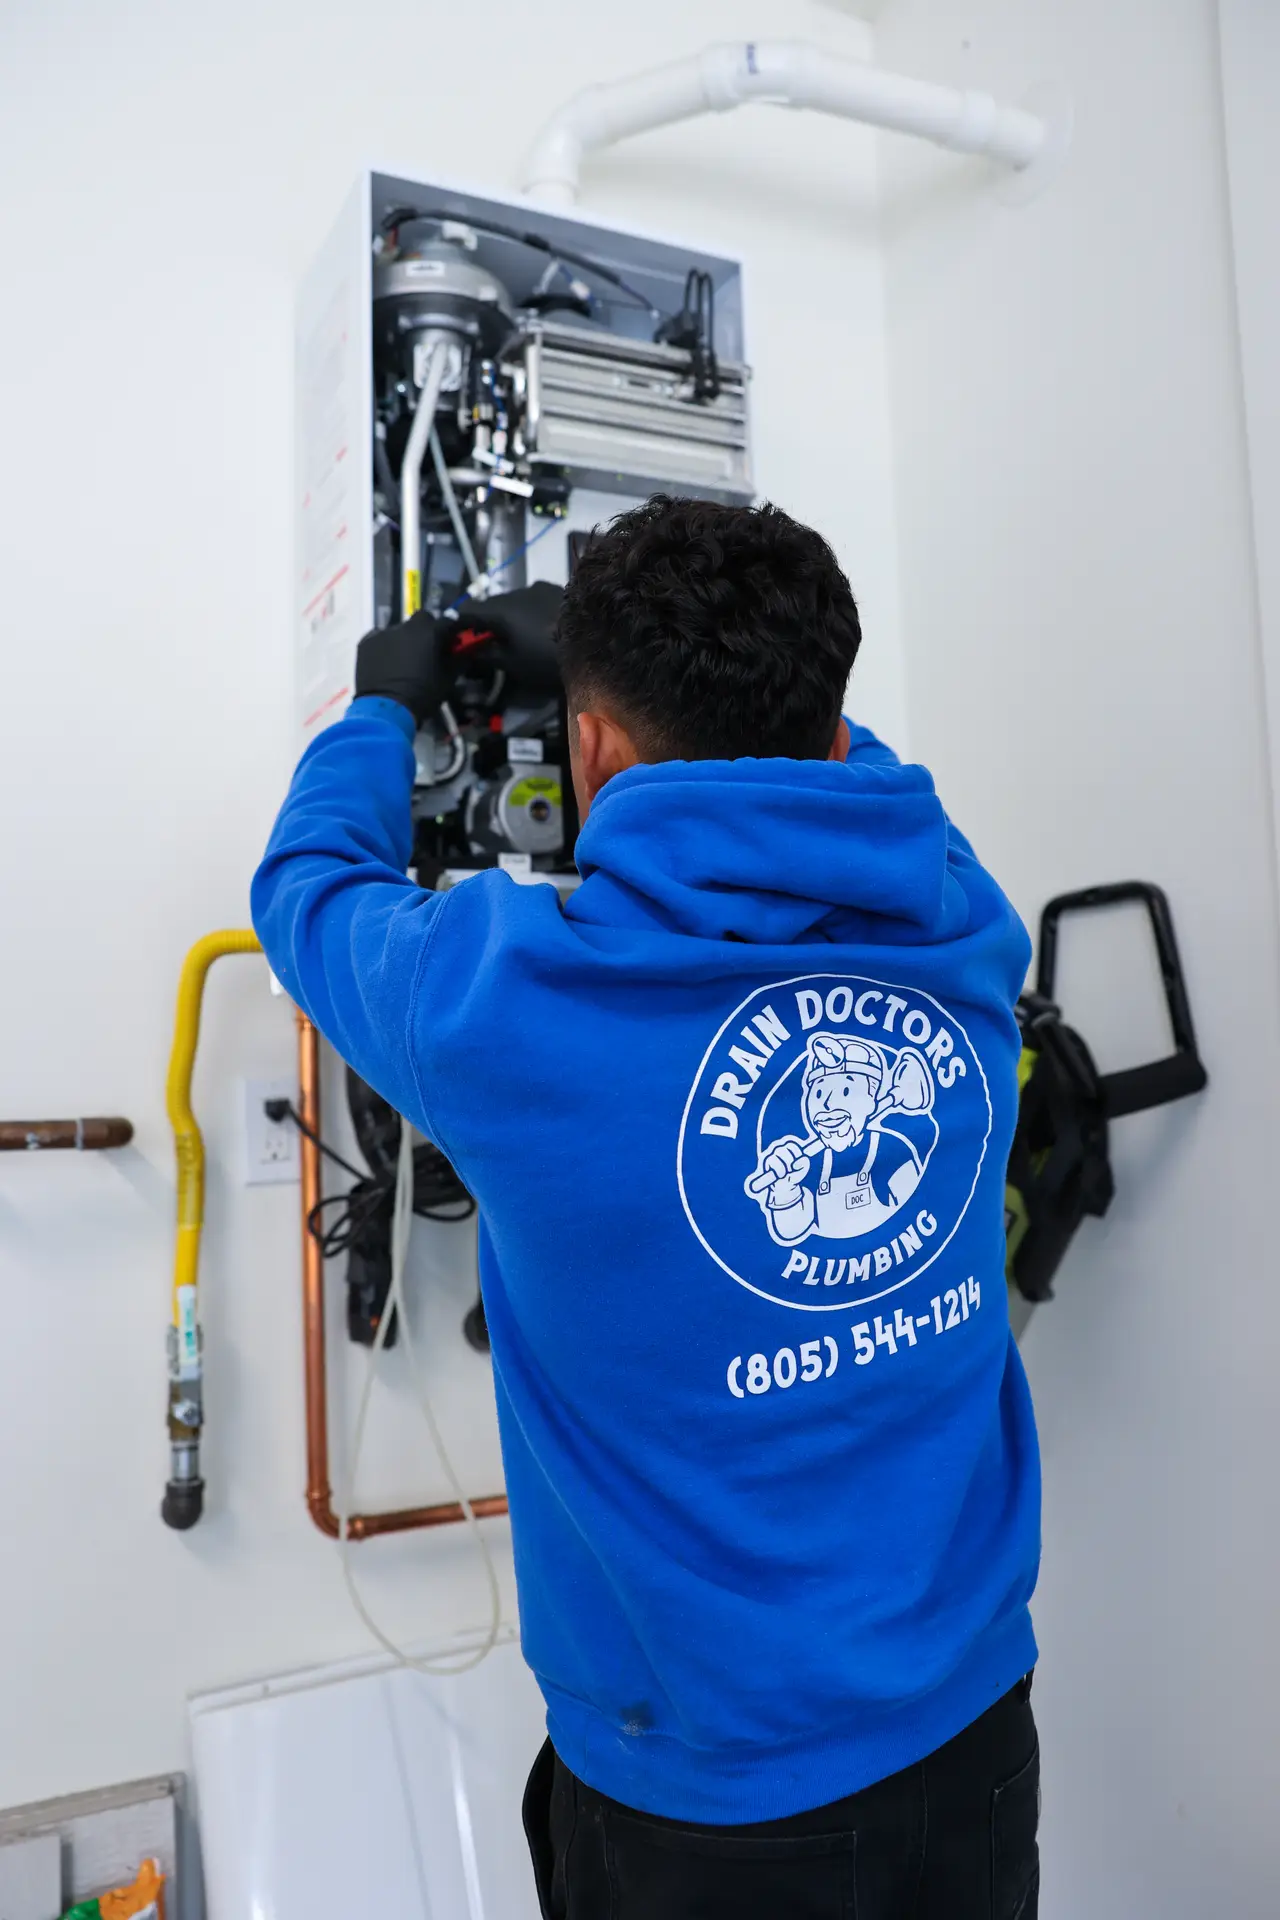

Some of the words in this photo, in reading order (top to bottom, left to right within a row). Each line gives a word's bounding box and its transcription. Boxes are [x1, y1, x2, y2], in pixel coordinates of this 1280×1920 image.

[700, 1004, 791, 1139] DRAIN
[795, 986, 966, 1089] DOCTORS
[781, 1209, 938, 1286] PLUMBING
[851, 1194, 864, 1205] DOC
[726, 1336, 839, 1398] (805)
[851, 1276, 981, 1365] 544-1214
